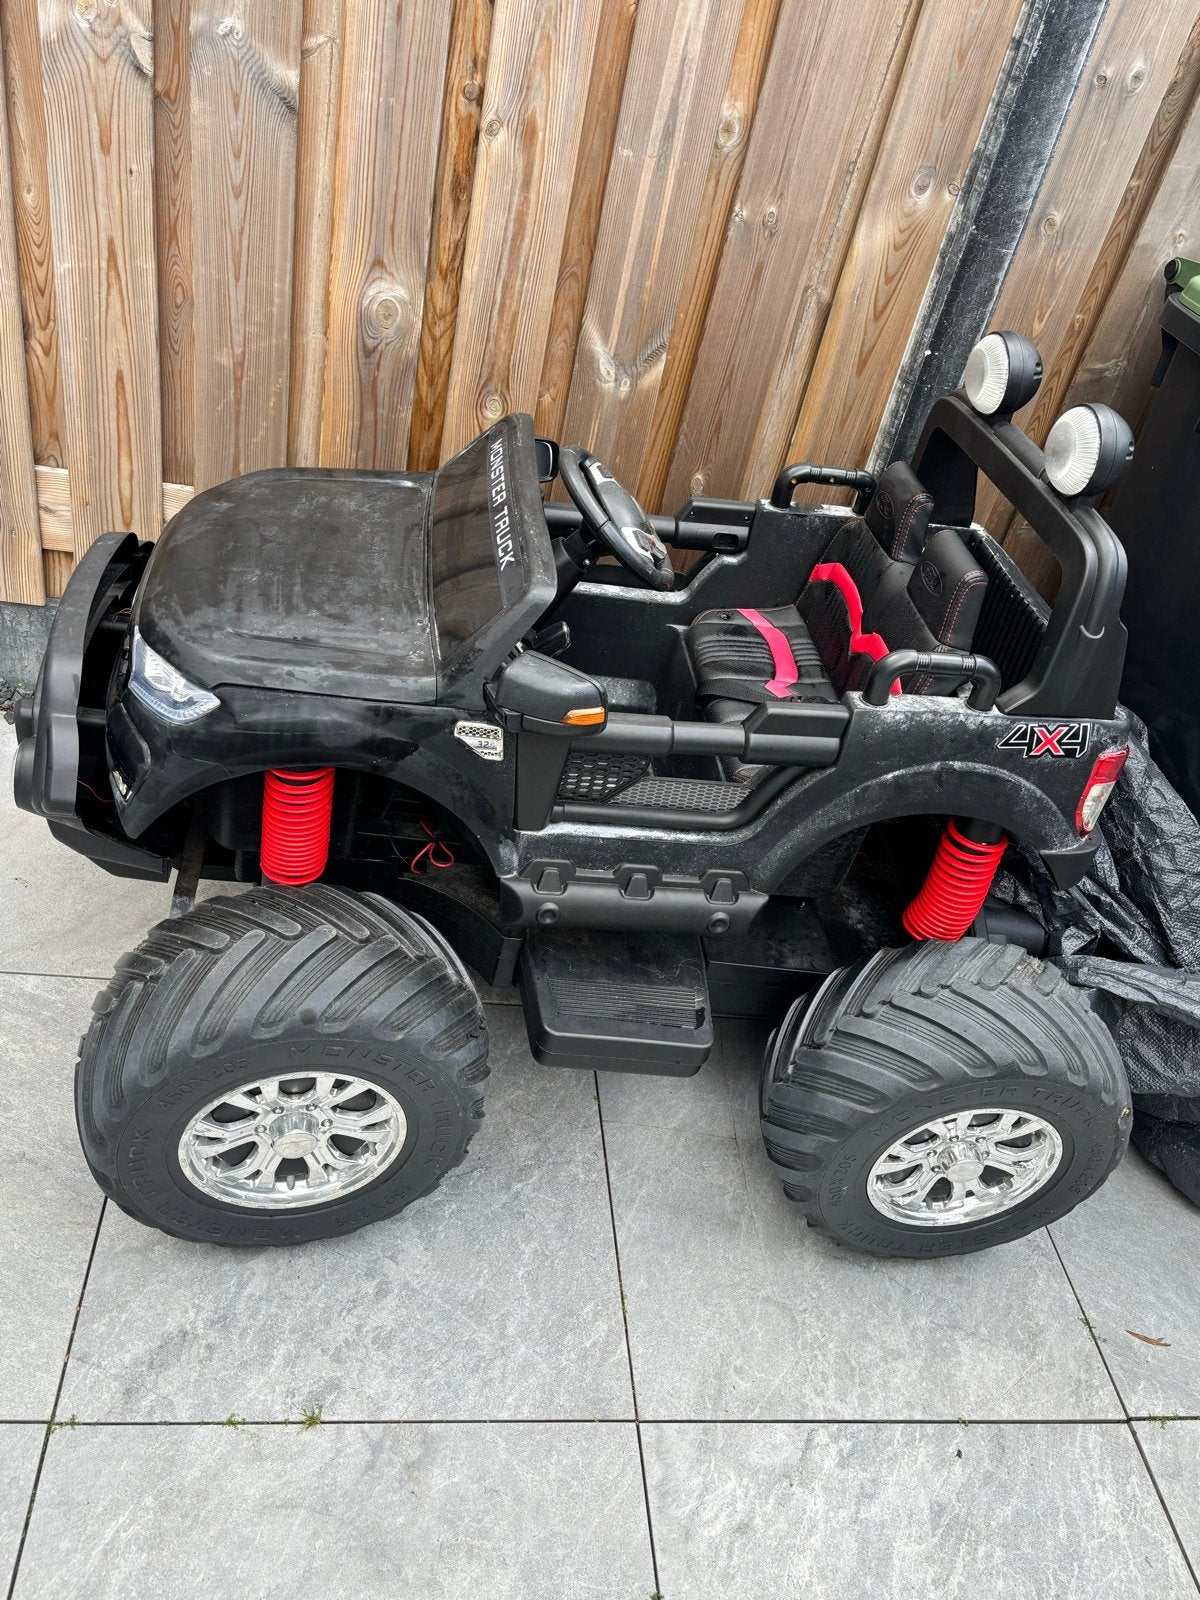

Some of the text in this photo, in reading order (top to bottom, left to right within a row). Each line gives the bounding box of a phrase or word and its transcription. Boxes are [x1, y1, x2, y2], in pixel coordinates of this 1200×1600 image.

[490, 438, 516, 572] MONSTER TRUCK
[288, 1044, 451, 1169] MONSTER TRUCK
[868, 1084, 1101, 1137] MONSTER TRUCK
[128, 1126, 303, 1240] MONSTER TRUCK
[836, 1217, 906, 1253] TRUCK
